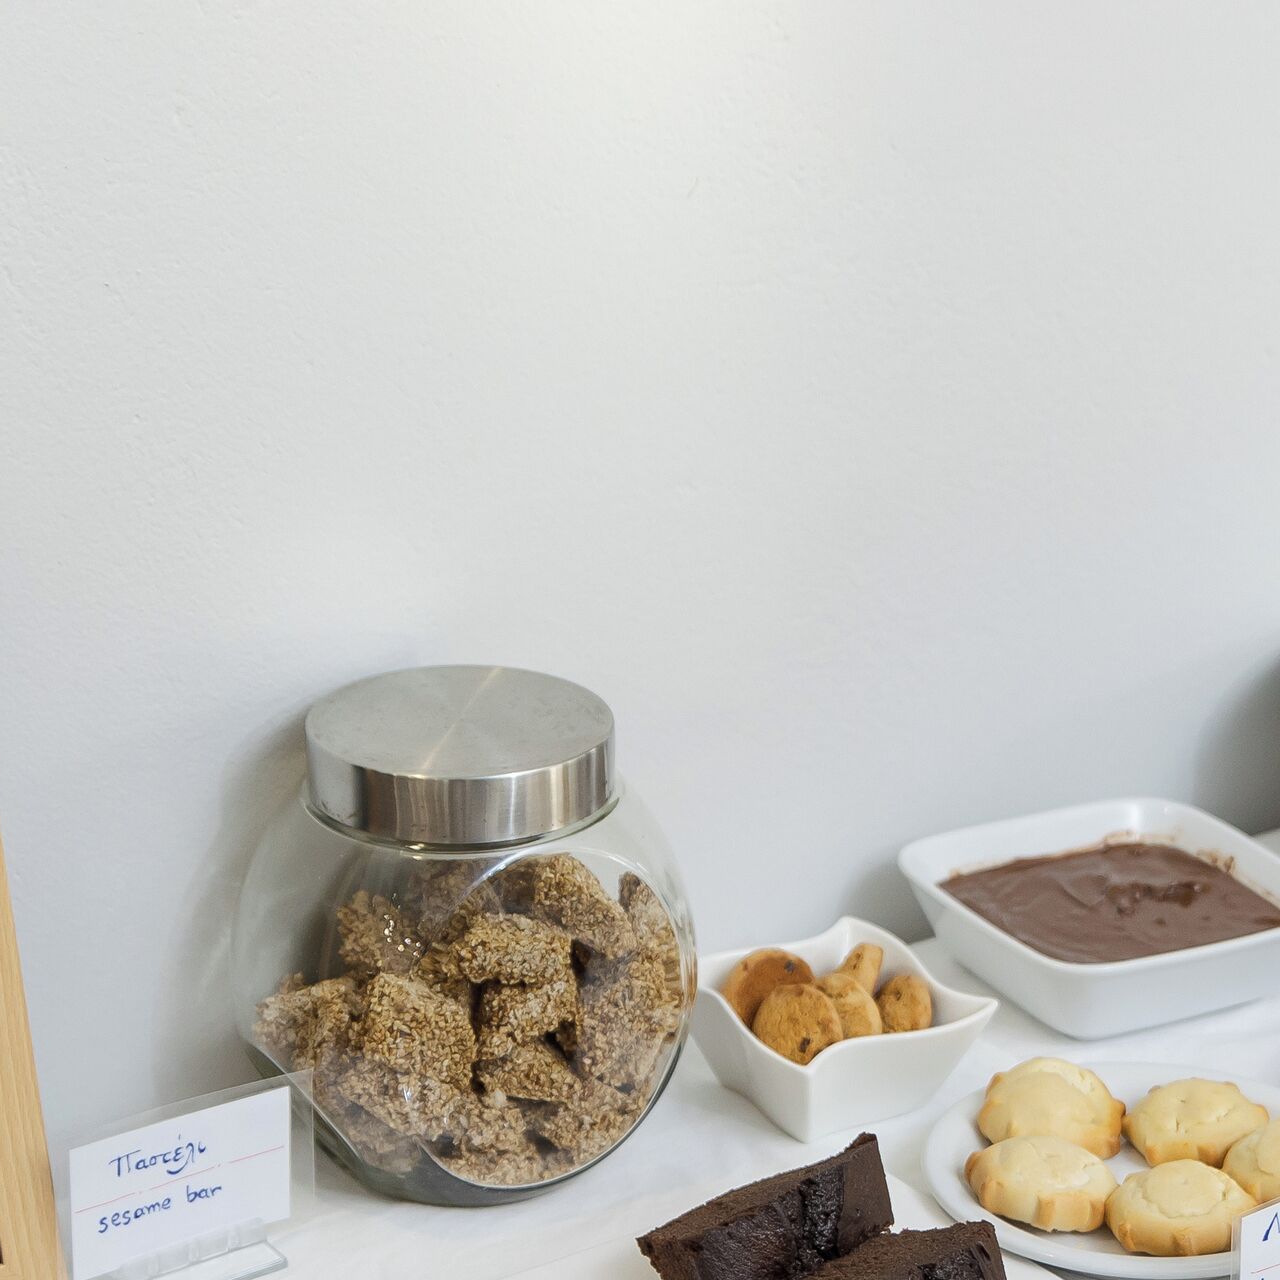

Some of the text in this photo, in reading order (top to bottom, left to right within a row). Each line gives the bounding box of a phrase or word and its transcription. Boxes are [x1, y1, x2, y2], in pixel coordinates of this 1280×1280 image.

[108, 1133, 207, 1177] Παστέλι
[98, 1184, 222, 1234] sesame bar
